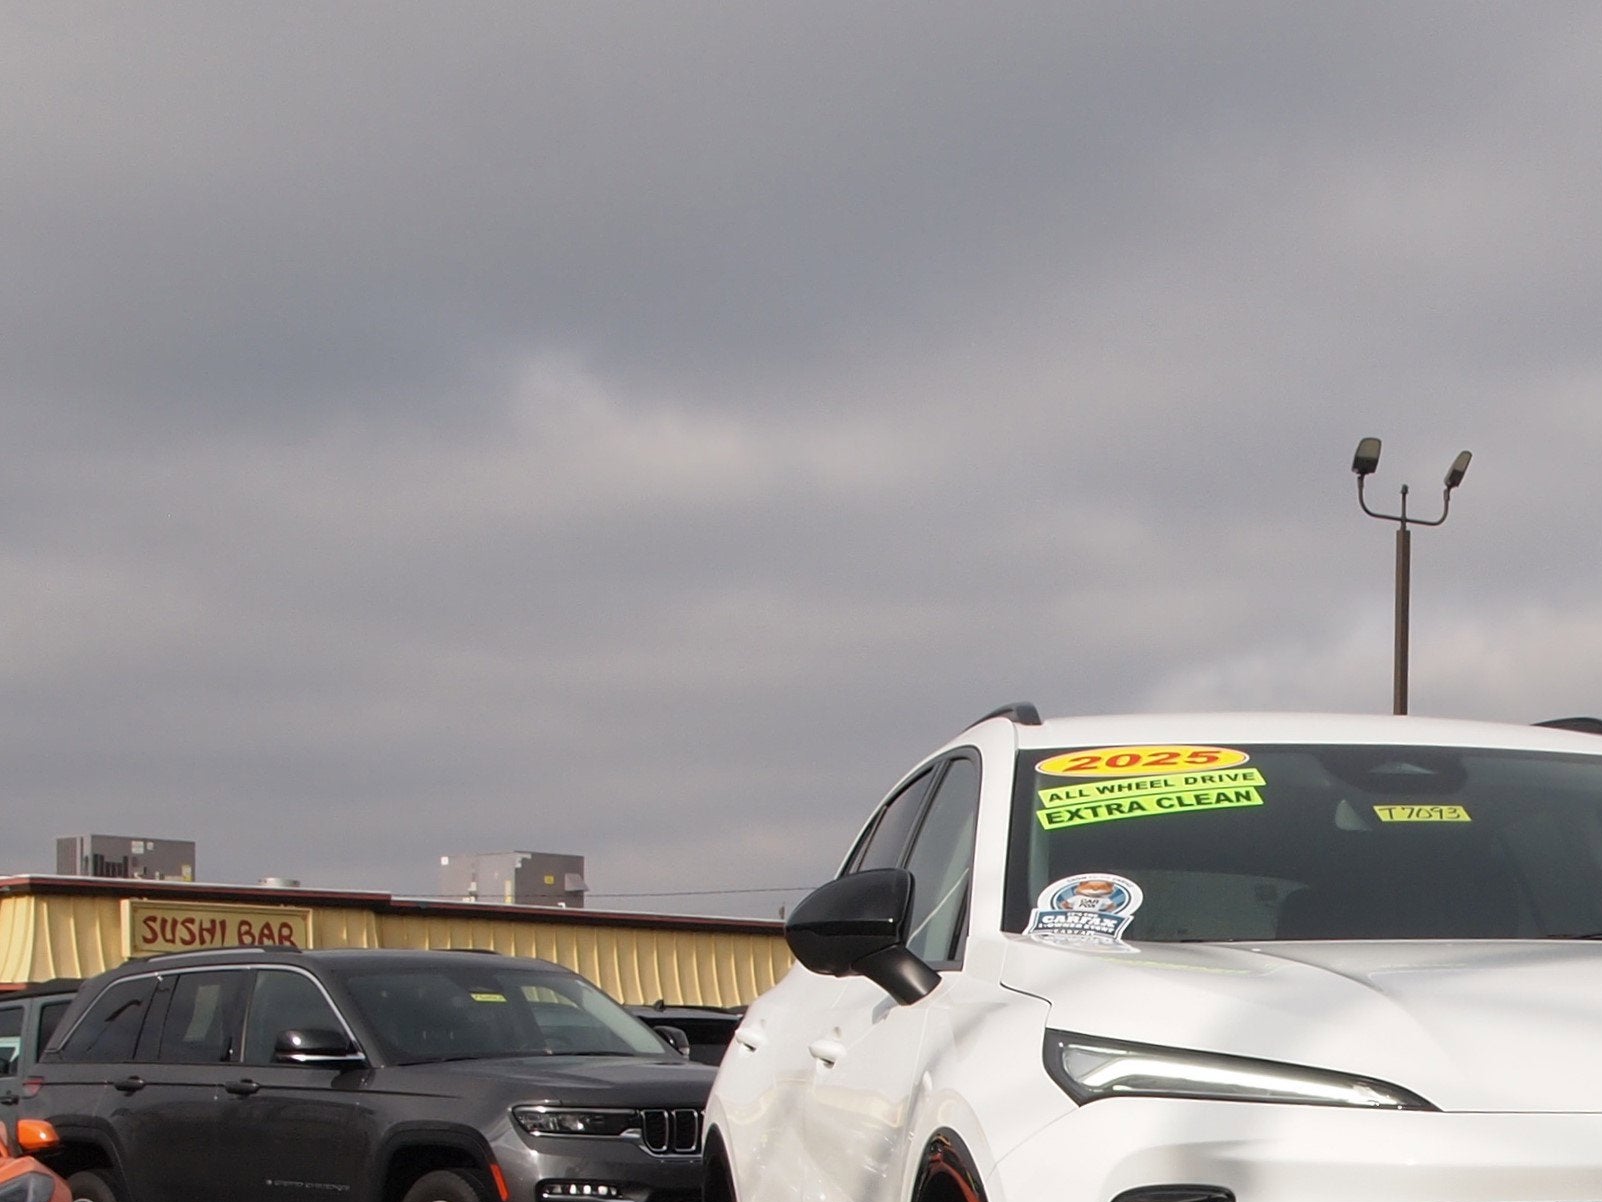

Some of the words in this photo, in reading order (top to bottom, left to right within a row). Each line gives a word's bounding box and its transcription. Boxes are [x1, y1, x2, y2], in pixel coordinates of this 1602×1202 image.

[1062, 751, 1221, 772] 2025
[1048, 788, 1091, 803] ALL
[1095, 778, 1175, 795] WHEEL
[1184, 771, 1256, 786] DRIVE
[1046, 799, 1147, 825] EXTRA
[1155, 789, 1254, 809] CLEAN
[142, 915, 227, 946] SUSHI
[237, 919, 299, 948] BAR
